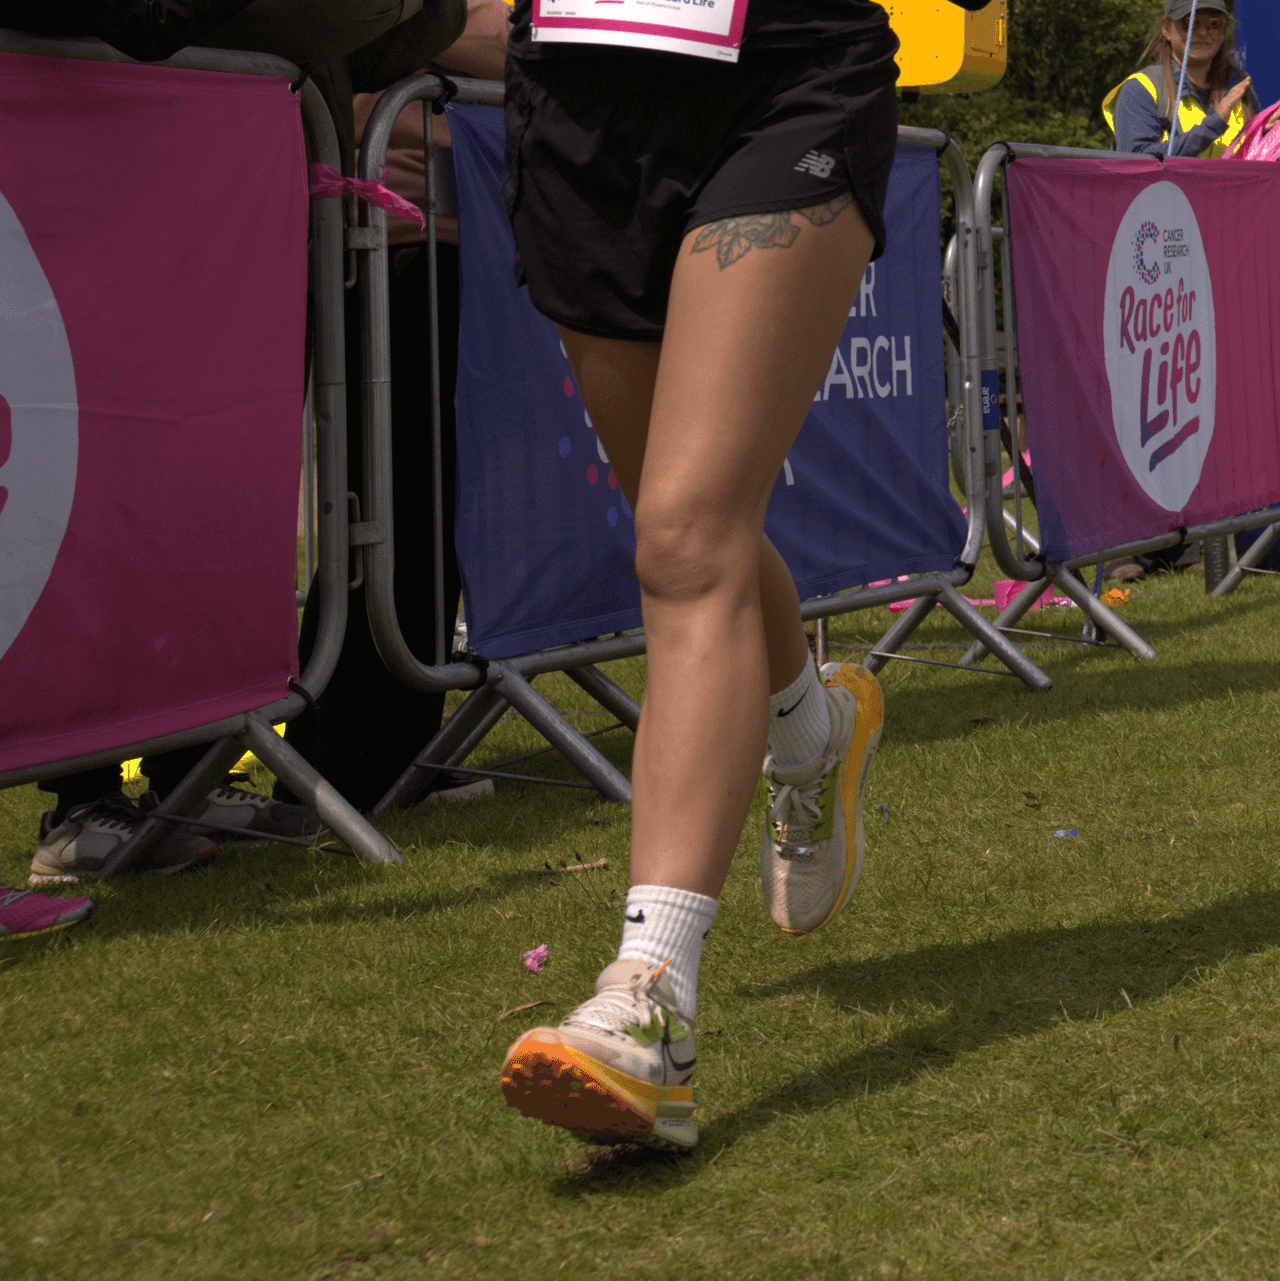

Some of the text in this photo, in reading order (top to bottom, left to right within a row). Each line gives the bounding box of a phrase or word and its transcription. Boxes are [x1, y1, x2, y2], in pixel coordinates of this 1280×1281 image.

[1163, 228, 1184, 243] CANCER
[1163, 245, 1190, 258] RESEARCH
[1163, 261, 1172, 275] UK
[1119, 277, 1197, 355] Race for
[813, 335, 913, 402] ARCH
[981, 386, 991, 414] arena
[1140, 329, 1201, 449] Life
